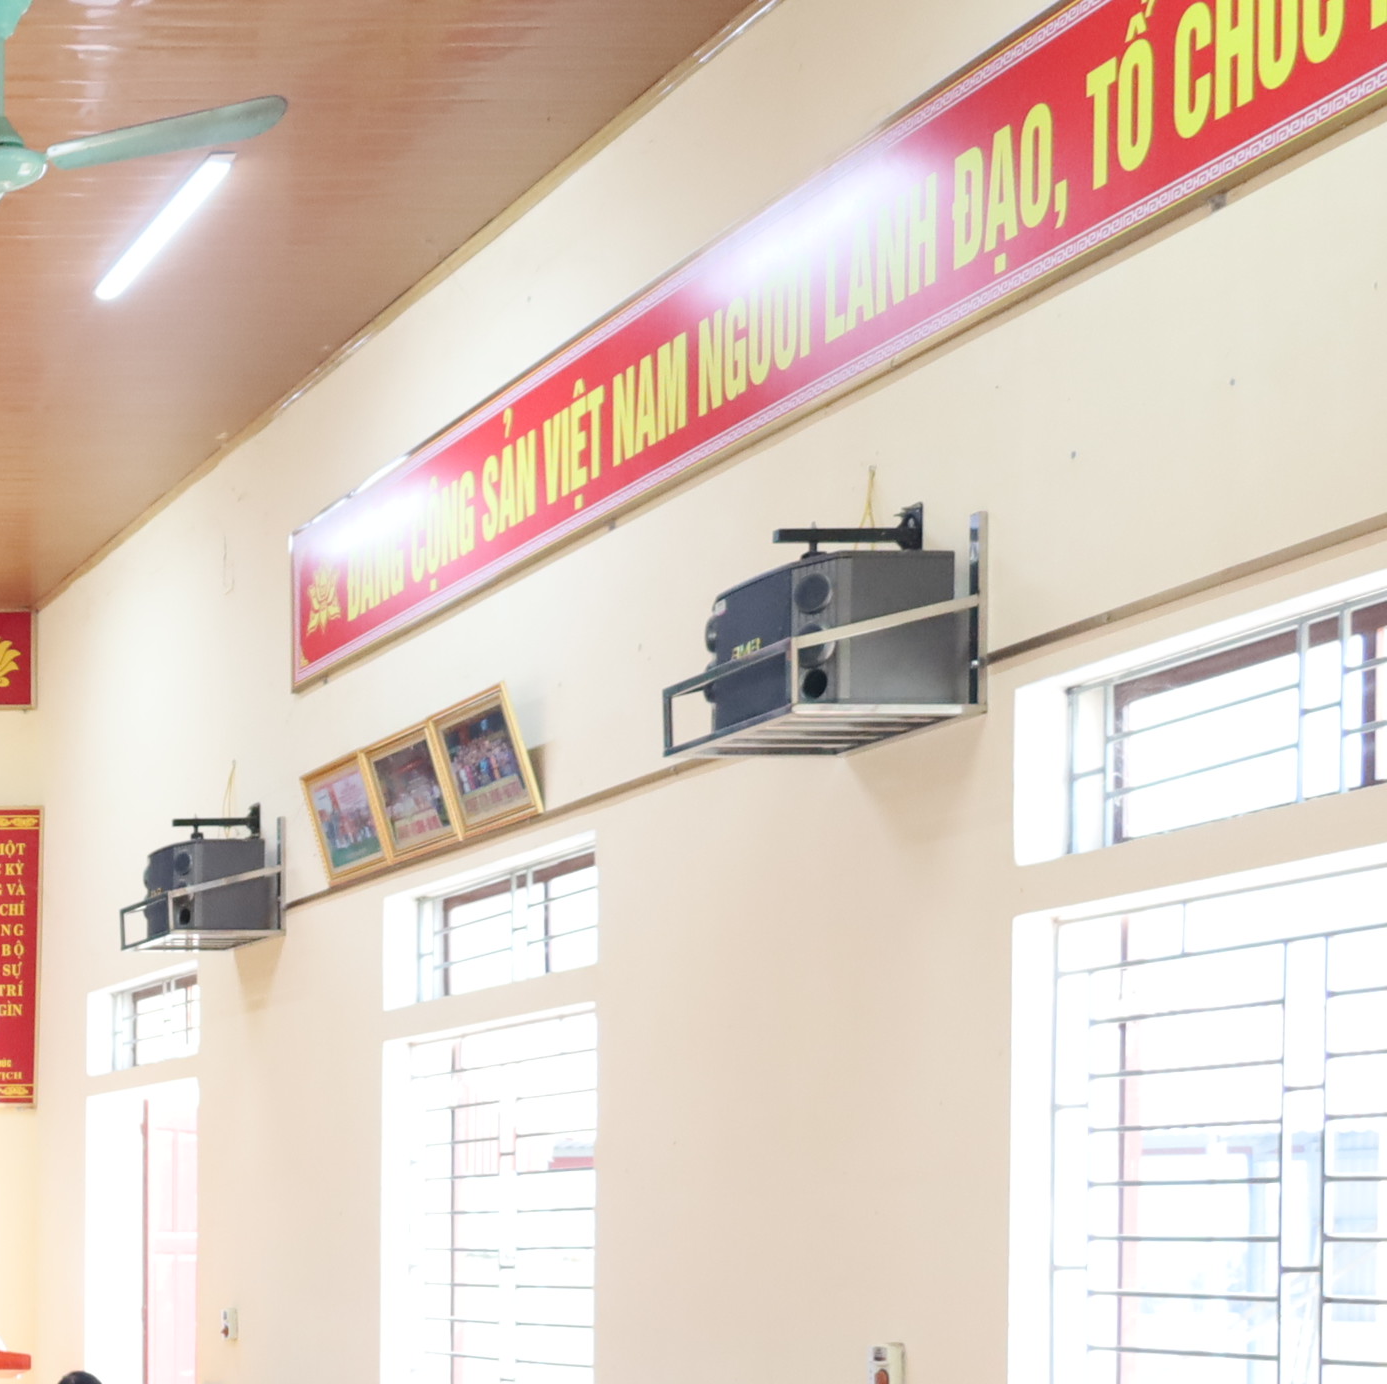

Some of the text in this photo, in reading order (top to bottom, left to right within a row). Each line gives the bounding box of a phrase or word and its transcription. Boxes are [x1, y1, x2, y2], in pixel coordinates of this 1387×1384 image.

[411, 471, 475, 592] CỘNG
[482, 408, 536, 542] SẢN
[543, 378, 604, 510] VIỆT
[613, 331, 689, 468] NAM
[952, 102, 1068, 275] ĐẠO,
[5, 860, 23, 875] KỲ
[6, 880, 25, 894] VÀ
[0, 901, 24, 915] CHÍ
[1, 940, 24, 959] BỘ
[2, 962, 21, 979] SỰ
